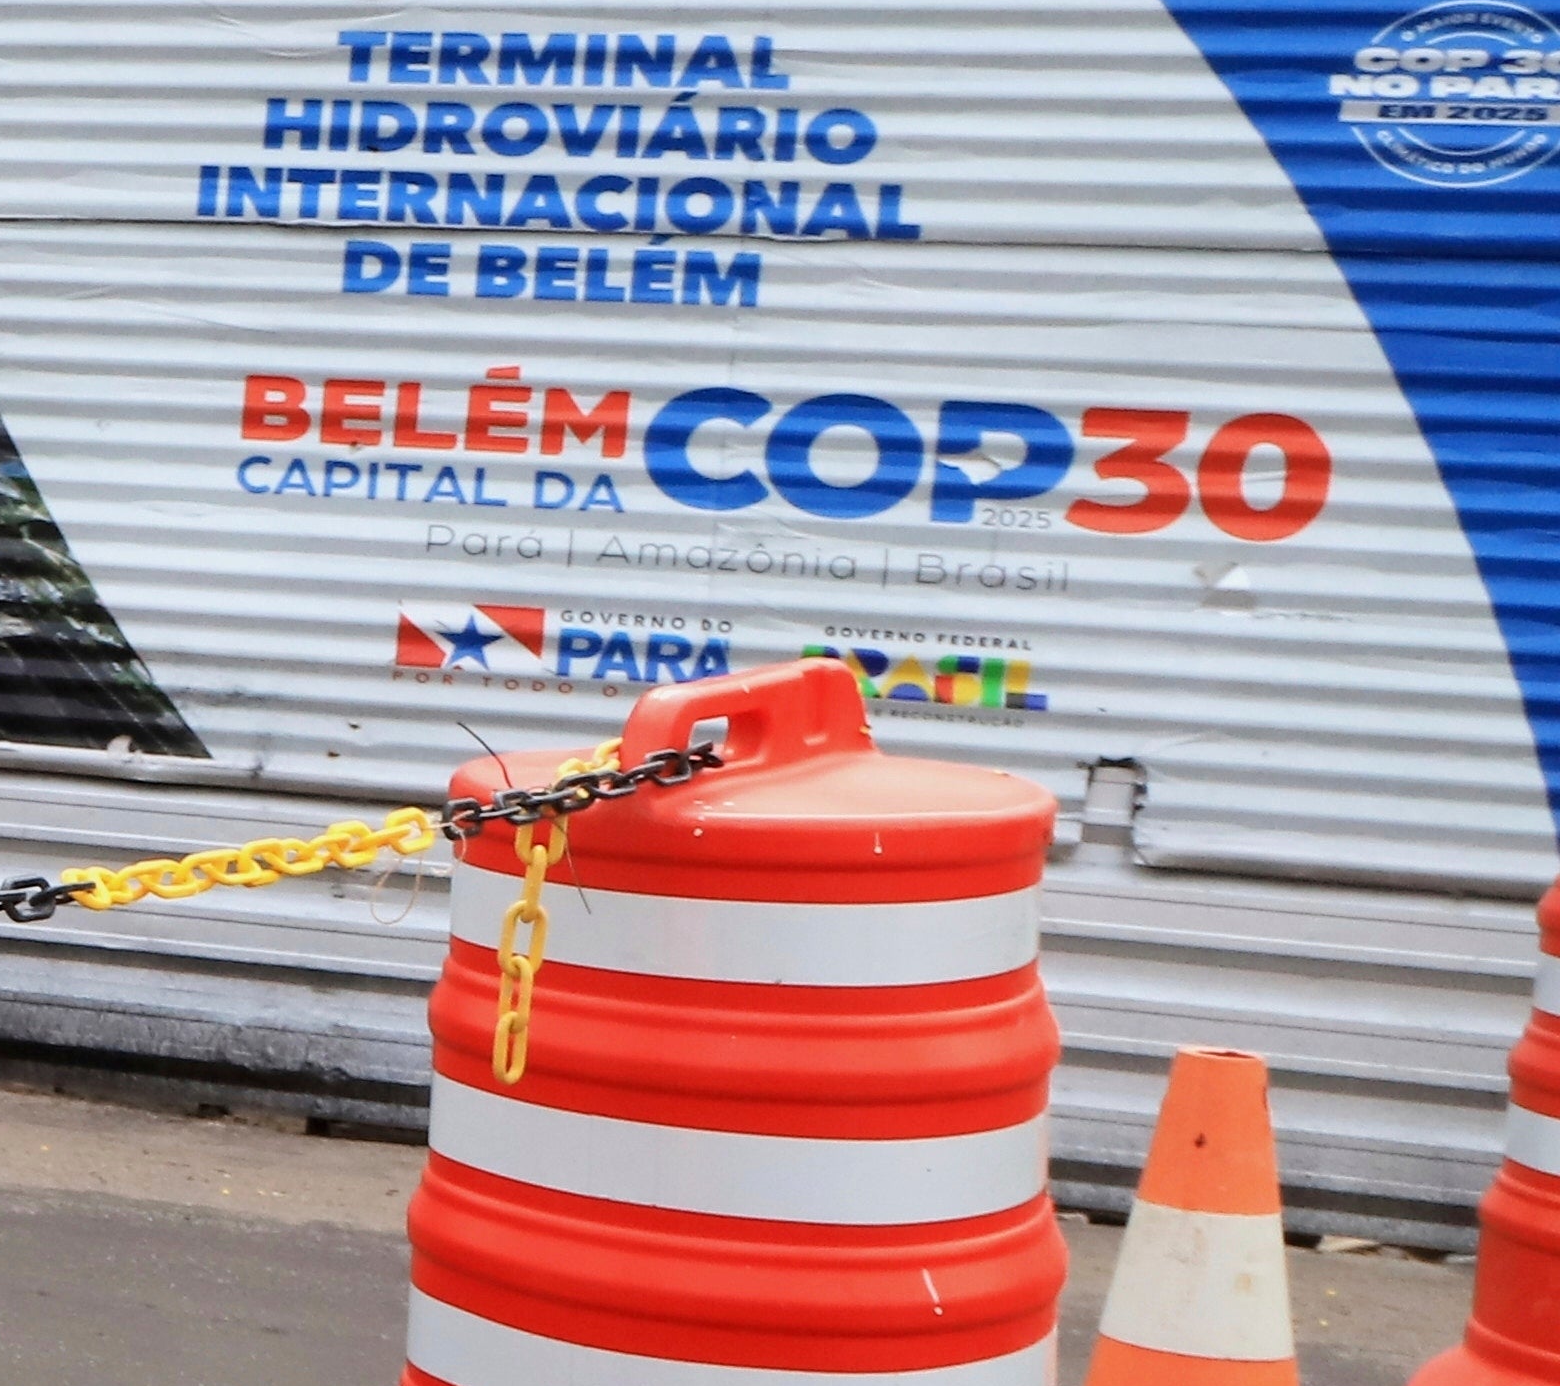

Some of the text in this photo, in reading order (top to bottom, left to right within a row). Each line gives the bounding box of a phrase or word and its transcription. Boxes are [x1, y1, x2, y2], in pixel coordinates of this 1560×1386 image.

[338, 31, 789, 89] TERMINAL
[1354, 46, 1490, 72] COP
[1329, 74, 1560, 99] NO PAR
[264, 92, 878, 166] HIDROVIÁRIO
[1378, 104, 1548, 121] EM 2025
[196, 166, 921, 240] INTERNACIONAL
[342, 235, 761, 307] DE BELÉM
[241, 366, 1333, 542] BELÉM COP30
[237, 456, 625, 513] CAPITAL DA
[982, 508, 1051, 528] 2025
[426, 524, 1069, 592] Pará Amazônia Brasil
[560, 610, 733, 633] GOVERNO DO
[824, 626, 1032, 651] GOVERNO FEDERAL
[392, 671, 618, 697] POR TODO O
